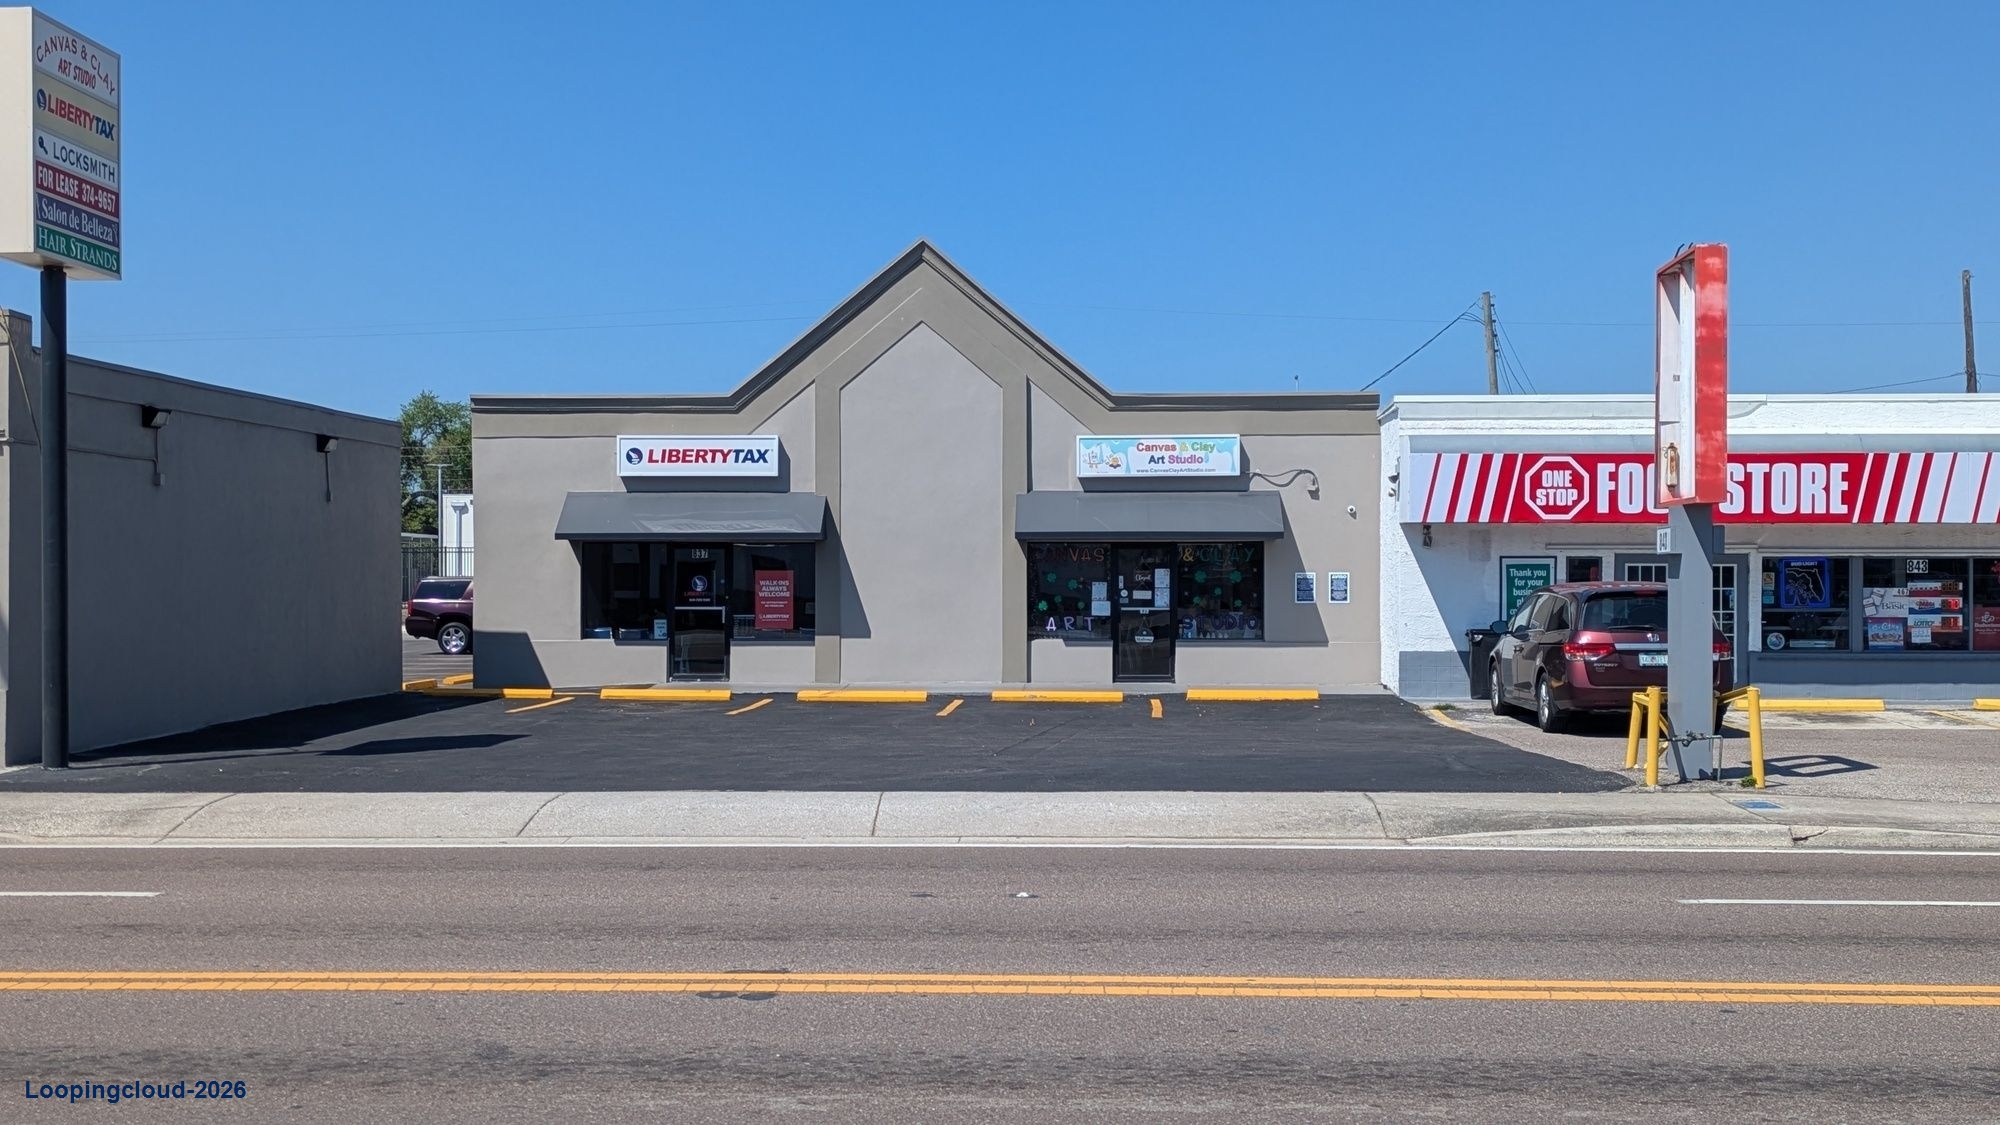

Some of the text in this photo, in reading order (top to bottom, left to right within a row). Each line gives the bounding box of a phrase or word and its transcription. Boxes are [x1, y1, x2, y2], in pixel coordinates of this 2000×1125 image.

[36, 35, 116, 96] CANVAS & CLAY
[58, 57, 96, 90] ART STUDIO
[47, 93, 116, 141] LIBERTYTAX
[53, 141, 116, 183] LOCKSMITH
[38, 165, 116, 213] FOR LEASE 374-9657
[41, 198, 114, 242] Salon de Belleza
[38, 227, 117, 271] HAIR STRANDS
[1136, 441, 1216, 453] Canvas & Clay
[1148, 454, 1204, 464] Art Studio
[1541, 469, 1573, 488] ONE
[1535, 488, 1578, 507] STOP
[1596, 462, 1849, 515] FO STORE
[1182, 547, 1194, 562] &
[1508, 568, 1547, 579] Thank you
[1907, 560, 1928, 572] 843
[1514, 577, 1544, 588] for your
[1881, 602, 1905, 610] Basic
[1045, 616, 1095, 631] ART
[1182, 615, 1259, 631] STUDIO
